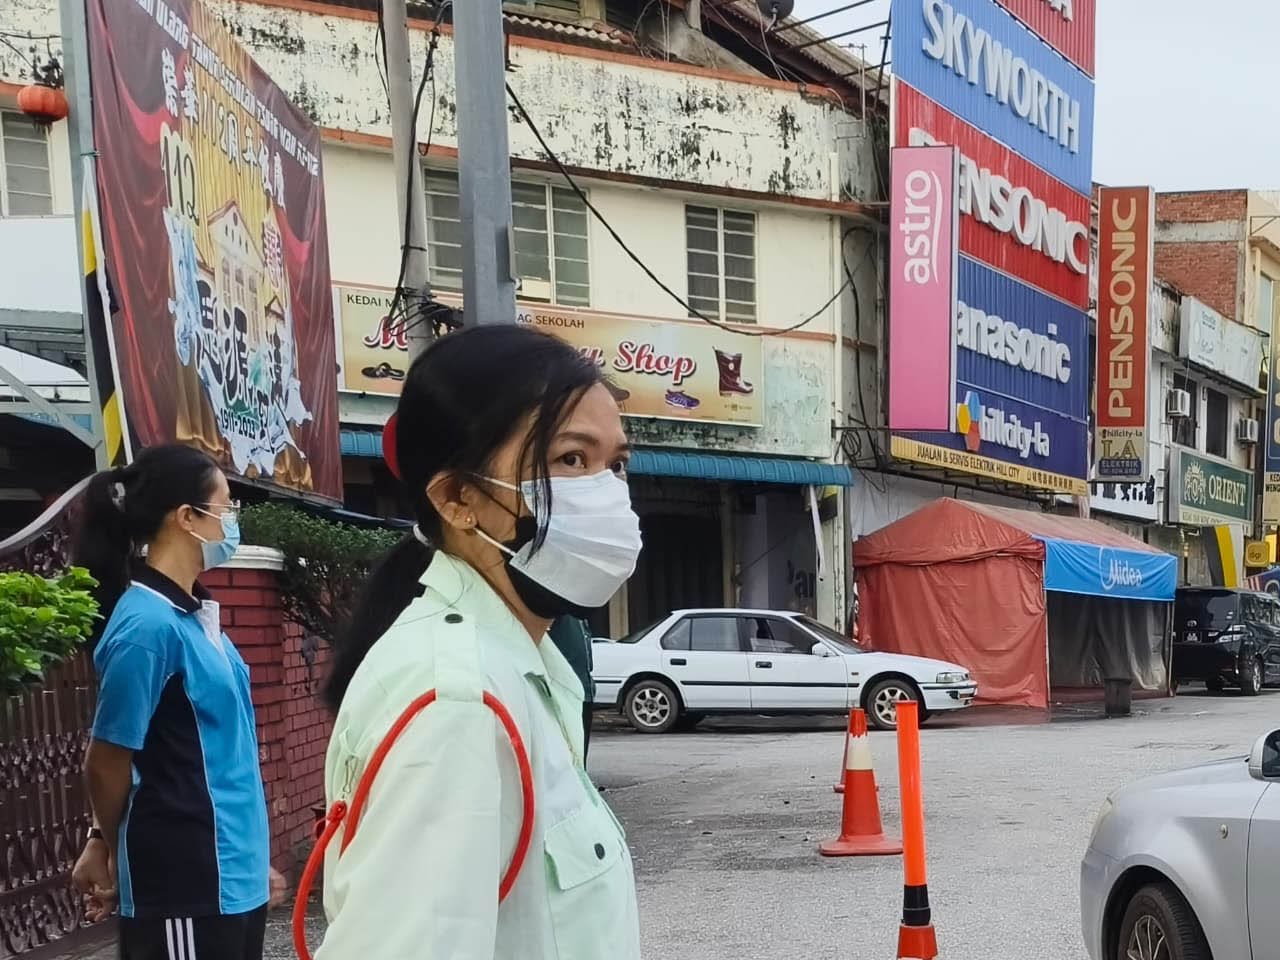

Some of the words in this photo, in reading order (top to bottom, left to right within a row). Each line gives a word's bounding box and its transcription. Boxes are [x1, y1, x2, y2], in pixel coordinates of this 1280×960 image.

[921, 0, 1081, 155] SKYWORTH
[909, 127, 1088, 275] ENSONIC
[899, 169, 932, 285] astro
[346, 293, 382, 306] KEDAI
[517, 313, 533, 324] AG
[535, 315, 585, 329] SEKOLAH
[1108, 197, 1138, 418] PENSONIC
[613, 340, 698, 386] Shop
[957, 300, 1072, 384] anasonic
[917, 444, 942, 464] JUALAN
[943, 451, 948, 463] &
[949, 452, 969, 469] SERVIS
[969, 457, 995, 474] ELEKTRIK
[996, 462, 1008, 475] HILL
[1008, 465, 1020, 478] CITY
[1208, 474, 1246, 507] ORIENT
[1101, 556, 1143, 588] Midea
